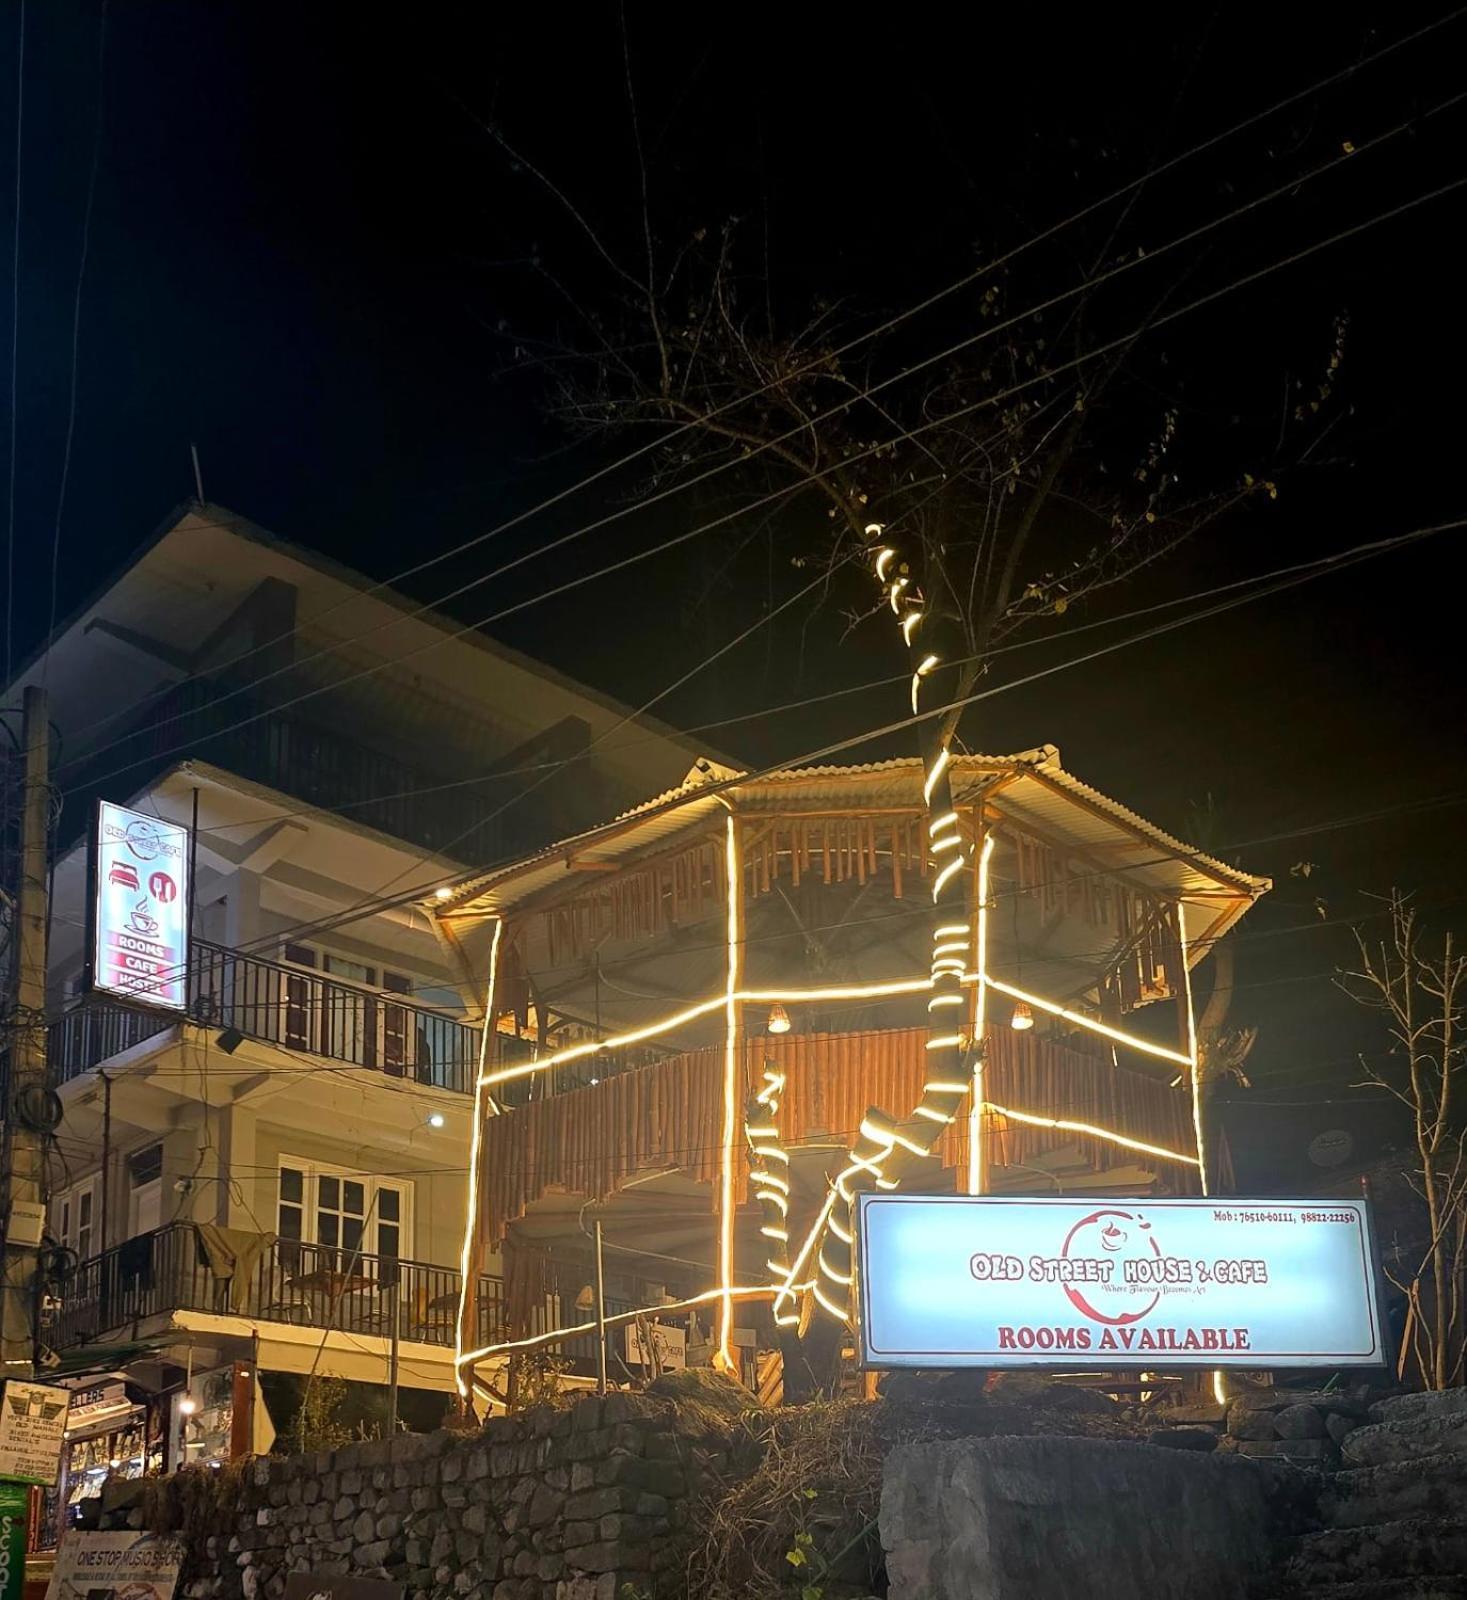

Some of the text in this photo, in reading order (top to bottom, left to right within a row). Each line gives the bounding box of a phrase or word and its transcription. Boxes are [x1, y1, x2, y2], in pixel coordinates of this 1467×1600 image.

[119, 936, 164, 957] ROOMS
[126, 956, 157, 973] CAFE
[970, 1253, 1268, 1283] OLD STREET HOUSE & CAFE
[1101, 1284, 1127, 1293] Where
[998, 1327, 1251, 1350] ROOMS AVAILABLE
[77, 1551, 97, 1566] ONE
[97, 1551, 121, 1566] STOP
[121, 1551, 151, 1566] MUSIC
